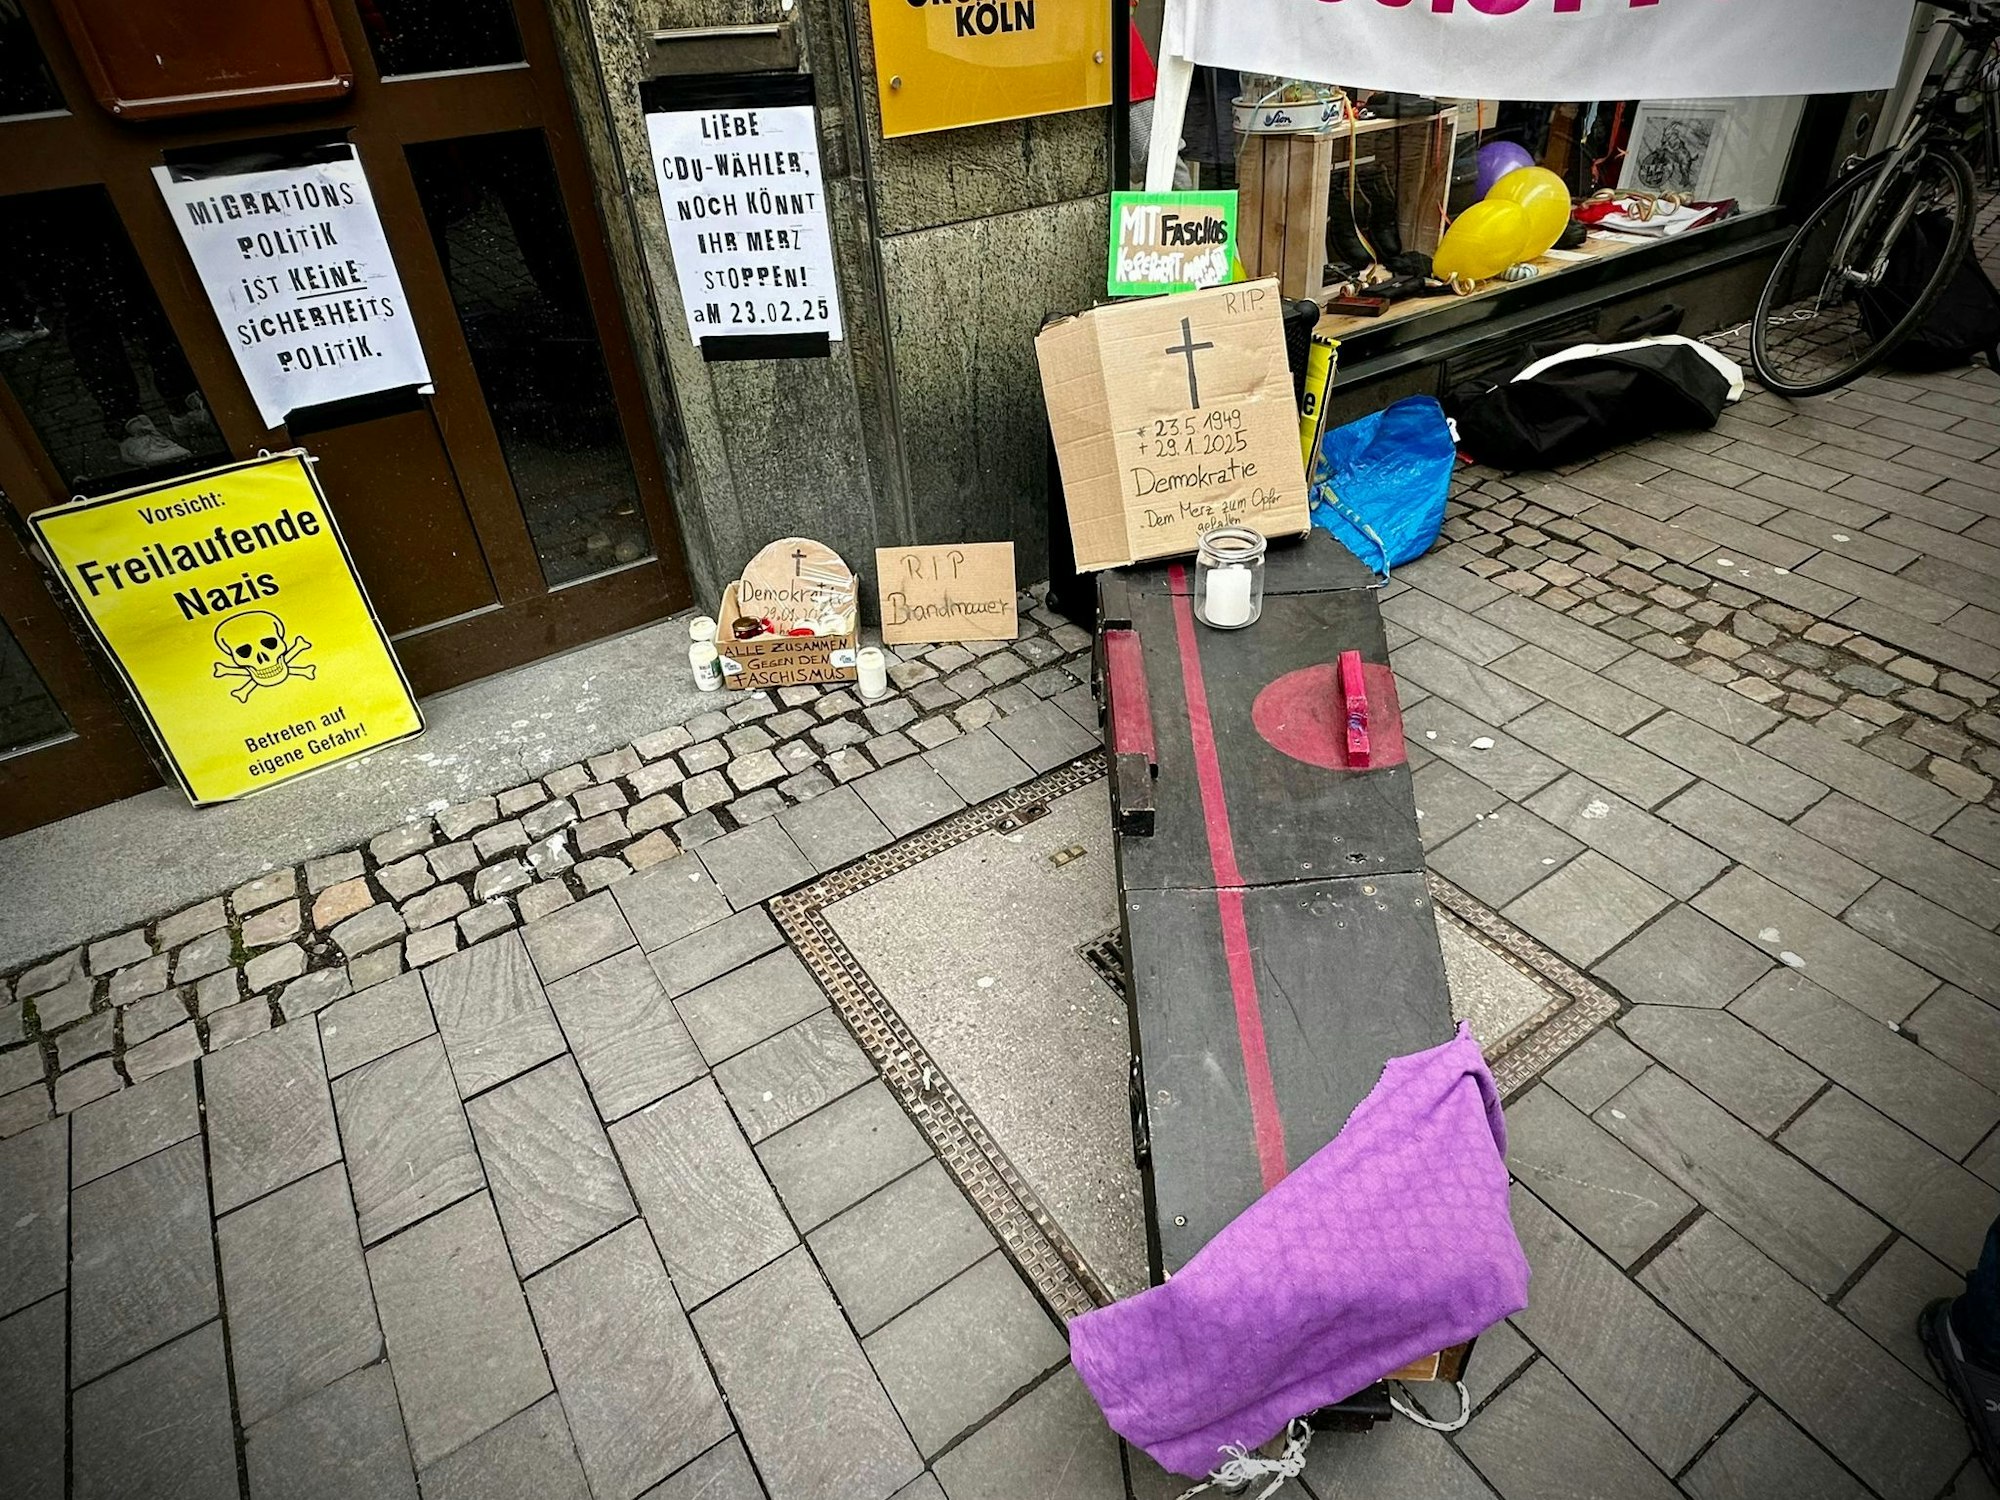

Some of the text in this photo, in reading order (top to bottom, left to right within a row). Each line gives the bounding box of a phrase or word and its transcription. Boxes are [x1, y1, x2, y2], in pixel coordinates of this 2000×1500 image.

[956, 0, 1035, 37] KÖLN
[663, 152, 810, 182] CDU-WÄHLER,
[677, 187, 815, 221] NOCH KÖNNT
[697, 229, 801, 254] IHR MERZ
[1119, 205, 1161, 246] MIT
[704, 265, 807, 290] STOPPEN!
[730, 299, 829, 324] 23.02.25
[1130, 457, 1258, 497] Demokratie
[138, 490, 226, 525] Vorsicht:
[1144, 509, 1175, 528] Dem
[1179, 501, 1214, 519] Merz
[1222, 497, 1246, 513] zum
[75, 508, 321, 597] Freilaufende
[173, 571, 280, 621] Nazis
[887, 588, 1010, 625] Brandmauer
[725, 638, 847, 658] ALLE ZUSAMMEN
[747, 657, 794, 670] GEGEN
[799, 654, 830, 665] DEN
[730, 667, 846, 687] FASCHISMUS
[244, 706, 348, 753] Betreten auf
[249, 723, 368, 777] eigene Gefahr!
